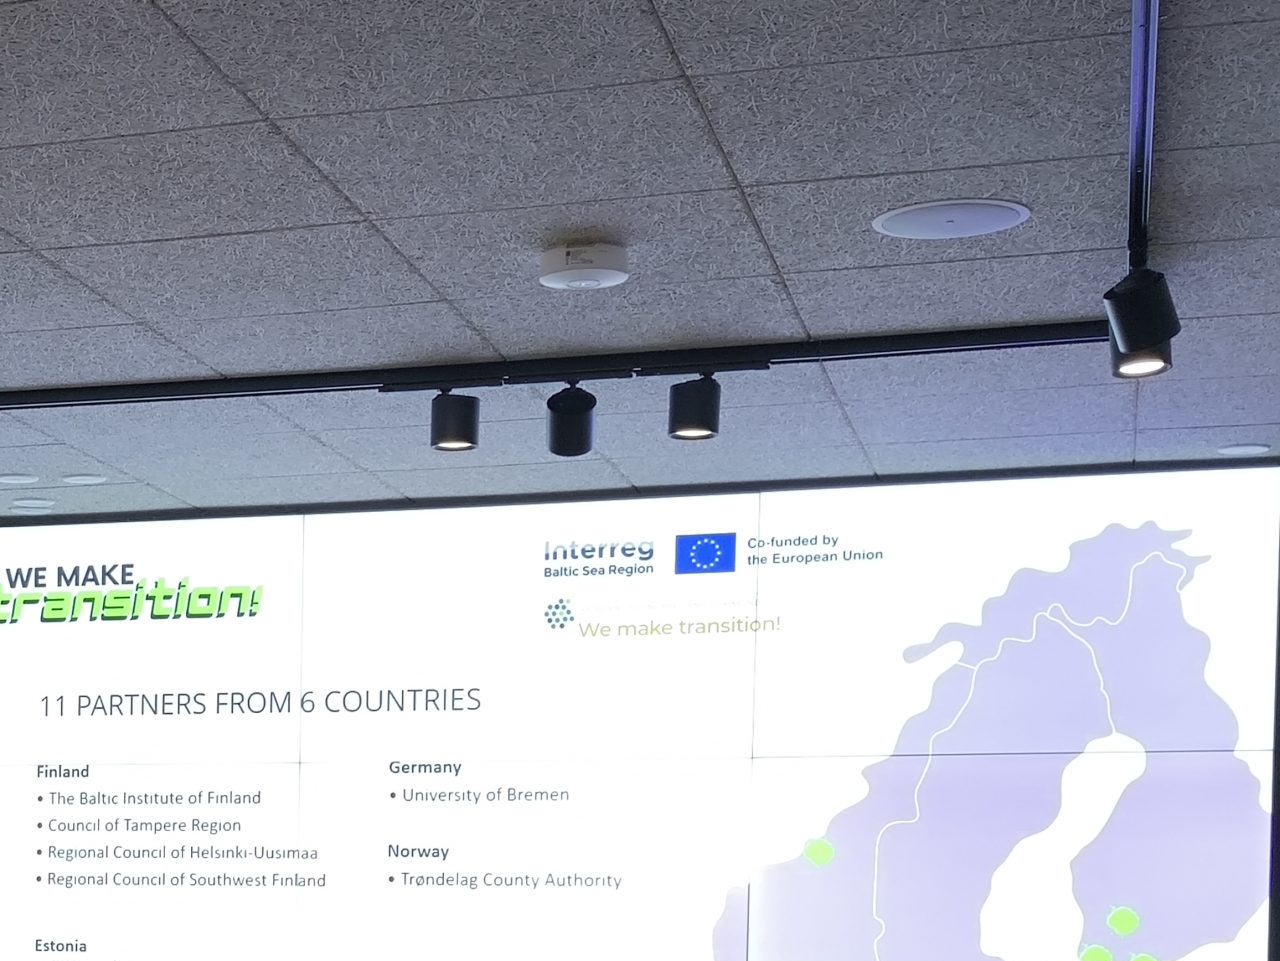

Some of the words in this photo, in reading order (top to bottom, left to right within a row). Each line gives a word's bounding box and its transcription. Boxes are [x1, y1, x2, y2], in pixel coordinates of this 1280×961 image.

[747, 535, 818, 549] Co-funded
[822, 534, 839, 548] by
[544, 541, 654, 561] Interreg
[747, 554, 768, 566] the
[772, 552, 838, 565] European
[842, 550, 883, 562] Union
[6, 567, 47, 588] WE
[57, 564, 135, 587] MAKE
[543, 566, 579, 578] Baltic
[582, 565, 606, 576] Sea
[608, 563, 654, 577] Region
[578, 622, 612, 639] We
[617, 618, 674, 637] make
[679, 615, 782, 636] transition!
[42, 696, 63, 716] 11
[78, 693, 206, 716] PARTNERS
[217, 692, 290, 714] FROM
[301, 691, 315, 713] 6
[325, 688, 480, 712] COUNTRIES
[37, 763, 90, 779] Finland
[388, 760, 462, 777] Germany
[49, 791, 75, 806] The
[79, 791, 119, 806] Baltic
[123, 791, 184, 805] Institute
[187, 790, 204, 805] of
[207, 790, 261, 805] Finland
[403, 788, 481, 805] University
[486, 787, 502, 802] of
[507, 787, 569, 802] Bremen
[48, 818, 100, 832] Council
[104, 817, 120, 832] of
[123, 818, 187, 835] Tampere
[191, 818, 241, 836] Region
[48, 845, 109, 862] Regional
[113, 845, 166, 859] Council
[170, 845, 186, 859] of
[190, 845, 318, 860] Helsinki-Uusimaa
[388, 844, 450, 862] Norway
[47, 872, 108, 889] Regional
[112, 872, 166, 886] Council
[170, 872, 185, 886] of
[189, 872, 267, 887] Southwest
[272, 872, 326, 888] Finland
[401, 872, 478, 890] Trøndelag
[483, 872, 540, 890] County
[544, 873, 622, 890] Authority
[35, 938, 87, 953] Estonia
